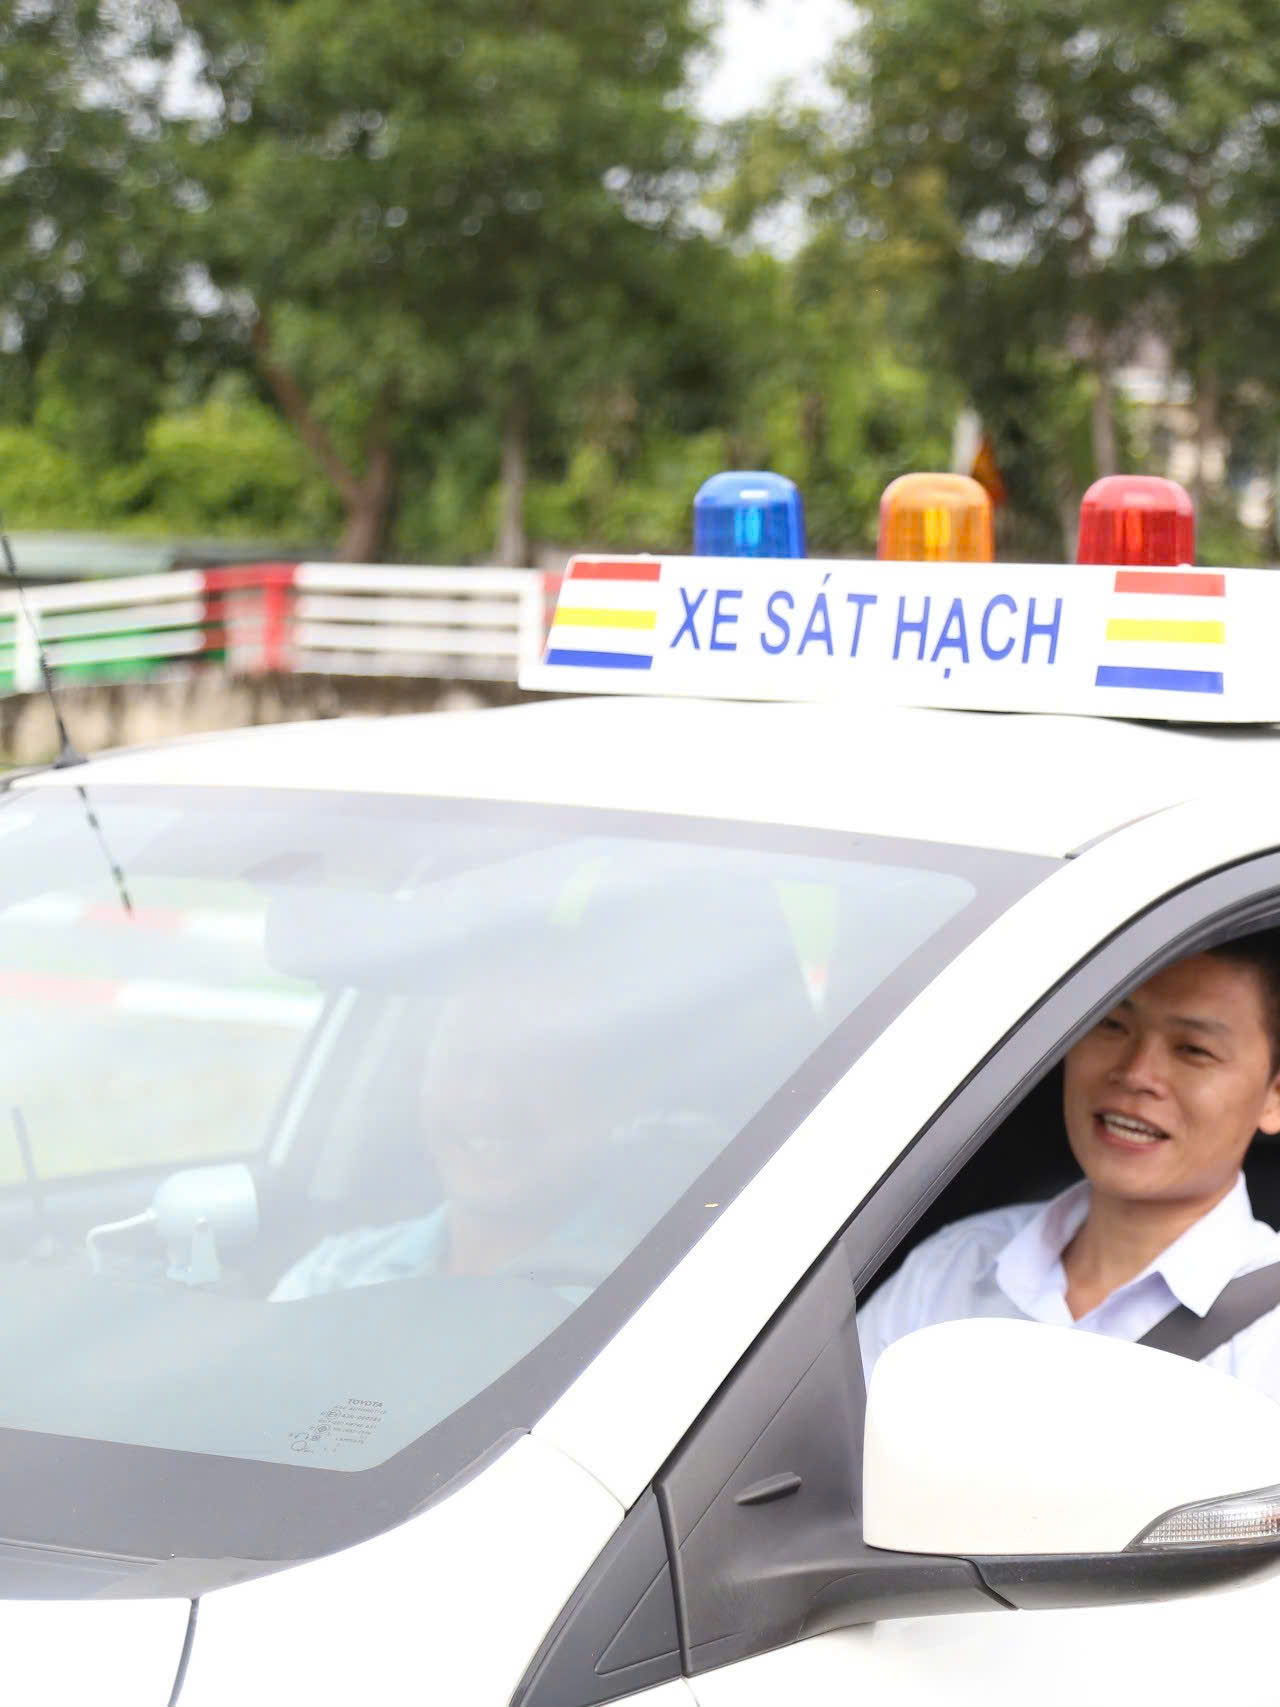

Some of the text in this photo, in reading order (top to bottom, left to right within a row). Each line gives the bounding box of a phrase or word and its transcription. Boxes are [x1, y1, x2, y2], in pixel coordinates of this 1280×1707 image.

[669, 573, 1063, 679] XE SÁT HẠCH
[348, 1398, 383, 1407] TOYOTA
